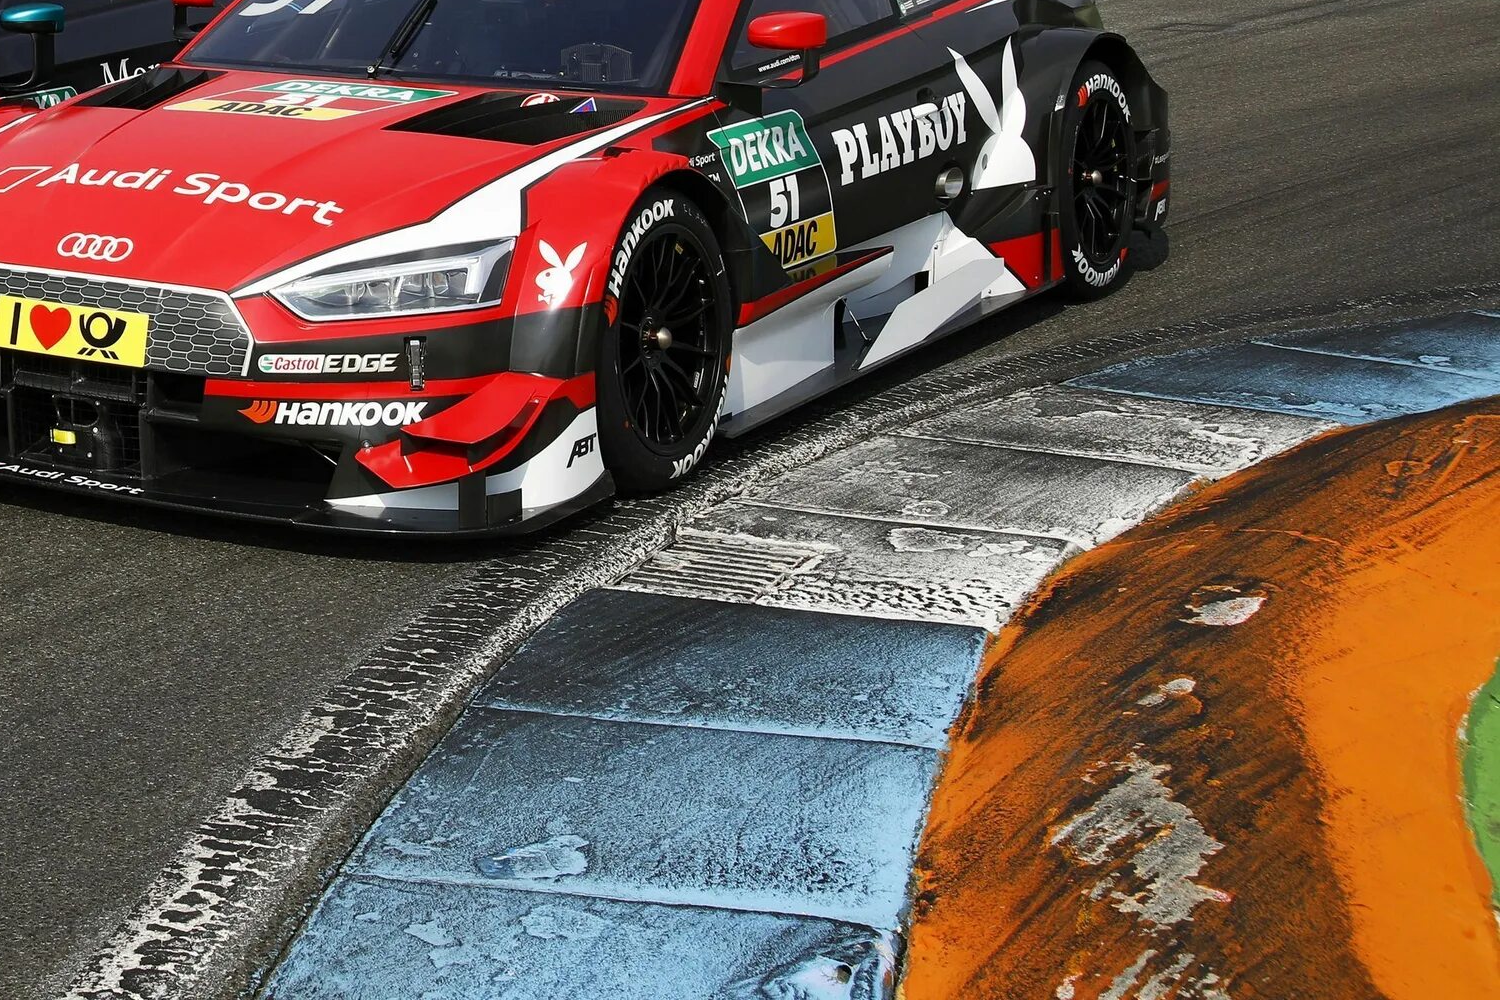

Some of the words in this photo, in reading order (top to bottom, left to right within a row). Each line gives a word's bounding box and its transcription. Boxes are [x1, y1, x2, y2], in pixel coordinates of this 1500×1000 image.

[210, 102, 312, 117] ADAC
[273, 81, 415, 101] DEKRA
[728, 121, 808, 177] DEKRA
[831, 91, 967, 187] PLAYBOY
[695, 152, 715, 168] Sport
[36, 162, 173, 191] Audi
[173, 172, 344, 227] Sport
[769, 174, 801, 229] 51
[773, 220, 818, 265] ADAC
[274, 356, 320, 372] Castrol
[321, 352, 400, 374] EDGE
[566, 432, 597, 469] ABT
[63, 475, 145, 495] Sport
